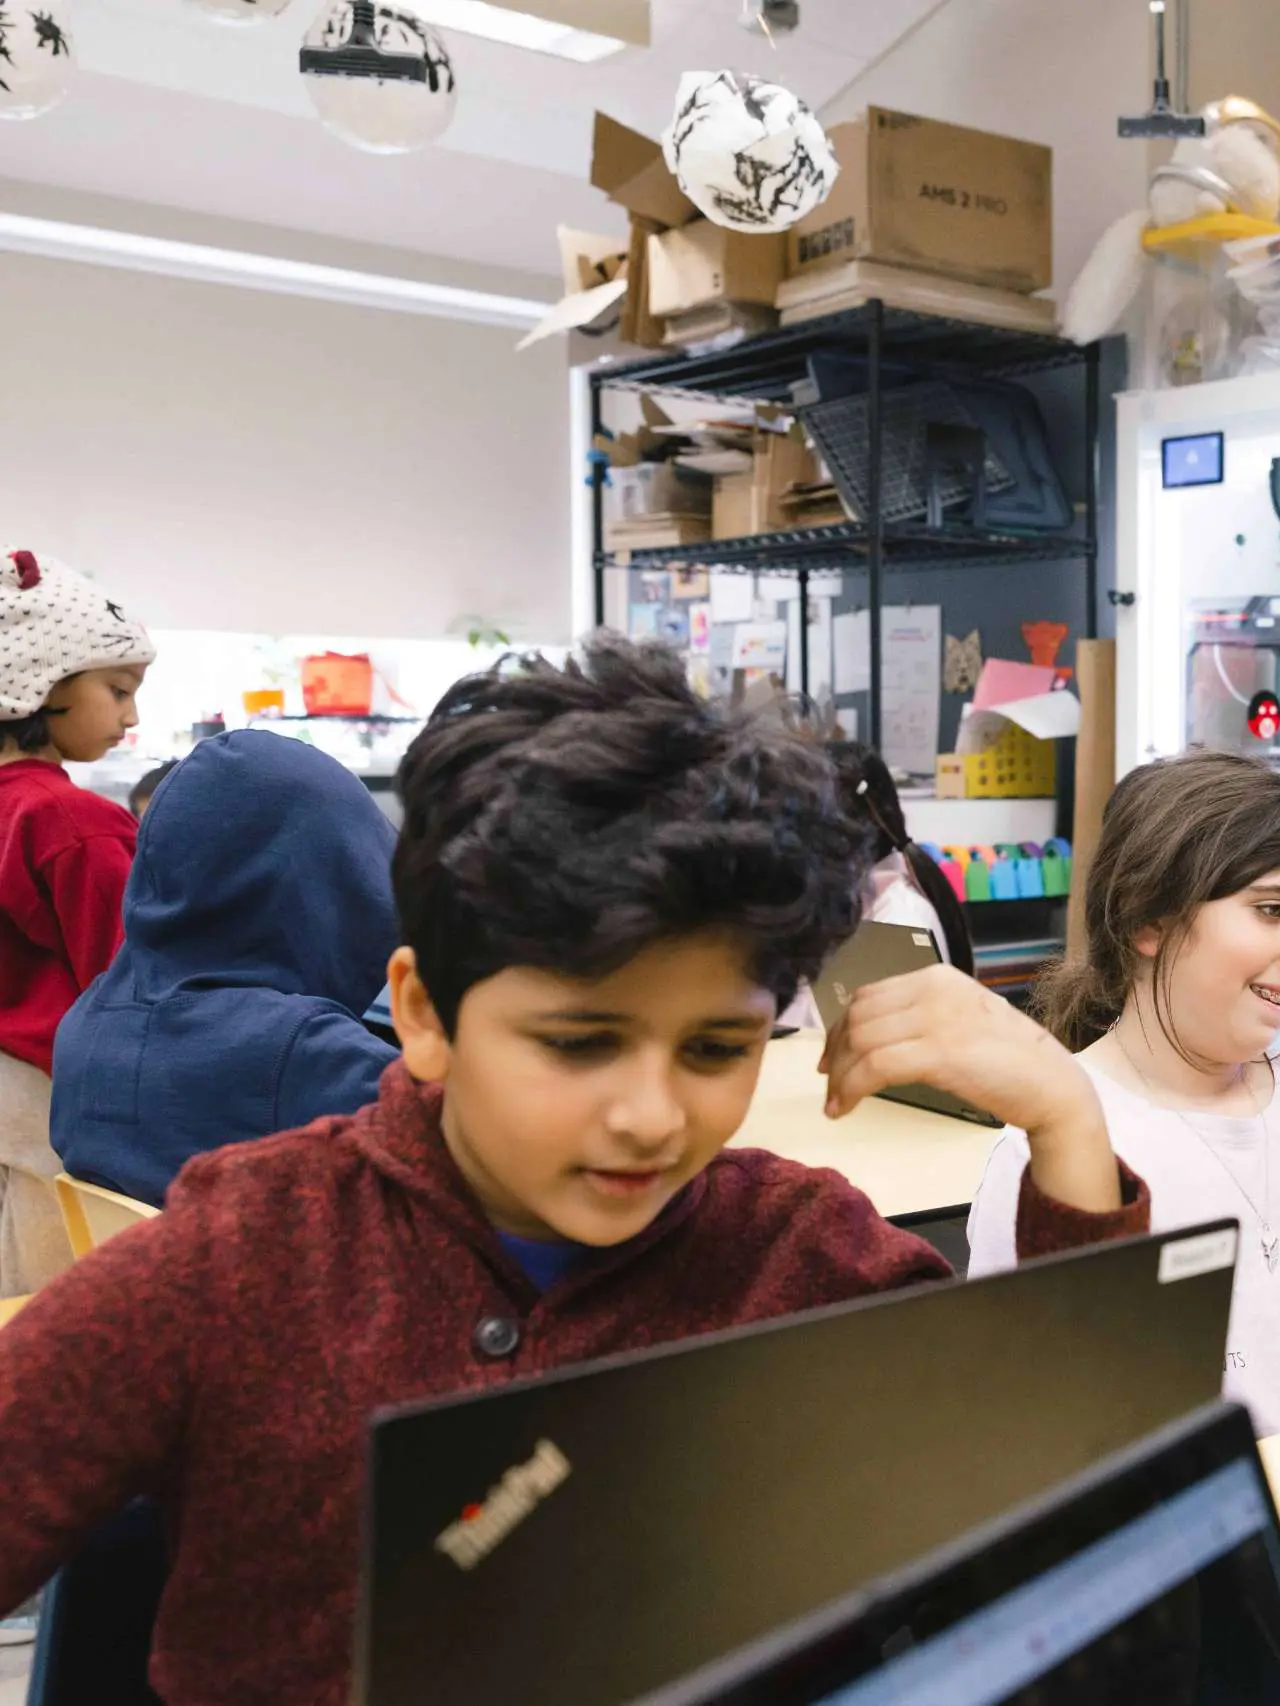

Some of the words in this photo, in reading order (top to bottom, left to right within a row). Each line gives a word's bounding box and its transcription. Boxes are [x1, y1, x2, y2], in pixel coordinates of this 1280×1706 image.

[919, 183, 956, 206] AMS
[961, 191, 971, 208] 2
[975, 192, 1008, 217] PRO
[435, 1437, 572, 1571] ThinkPad
